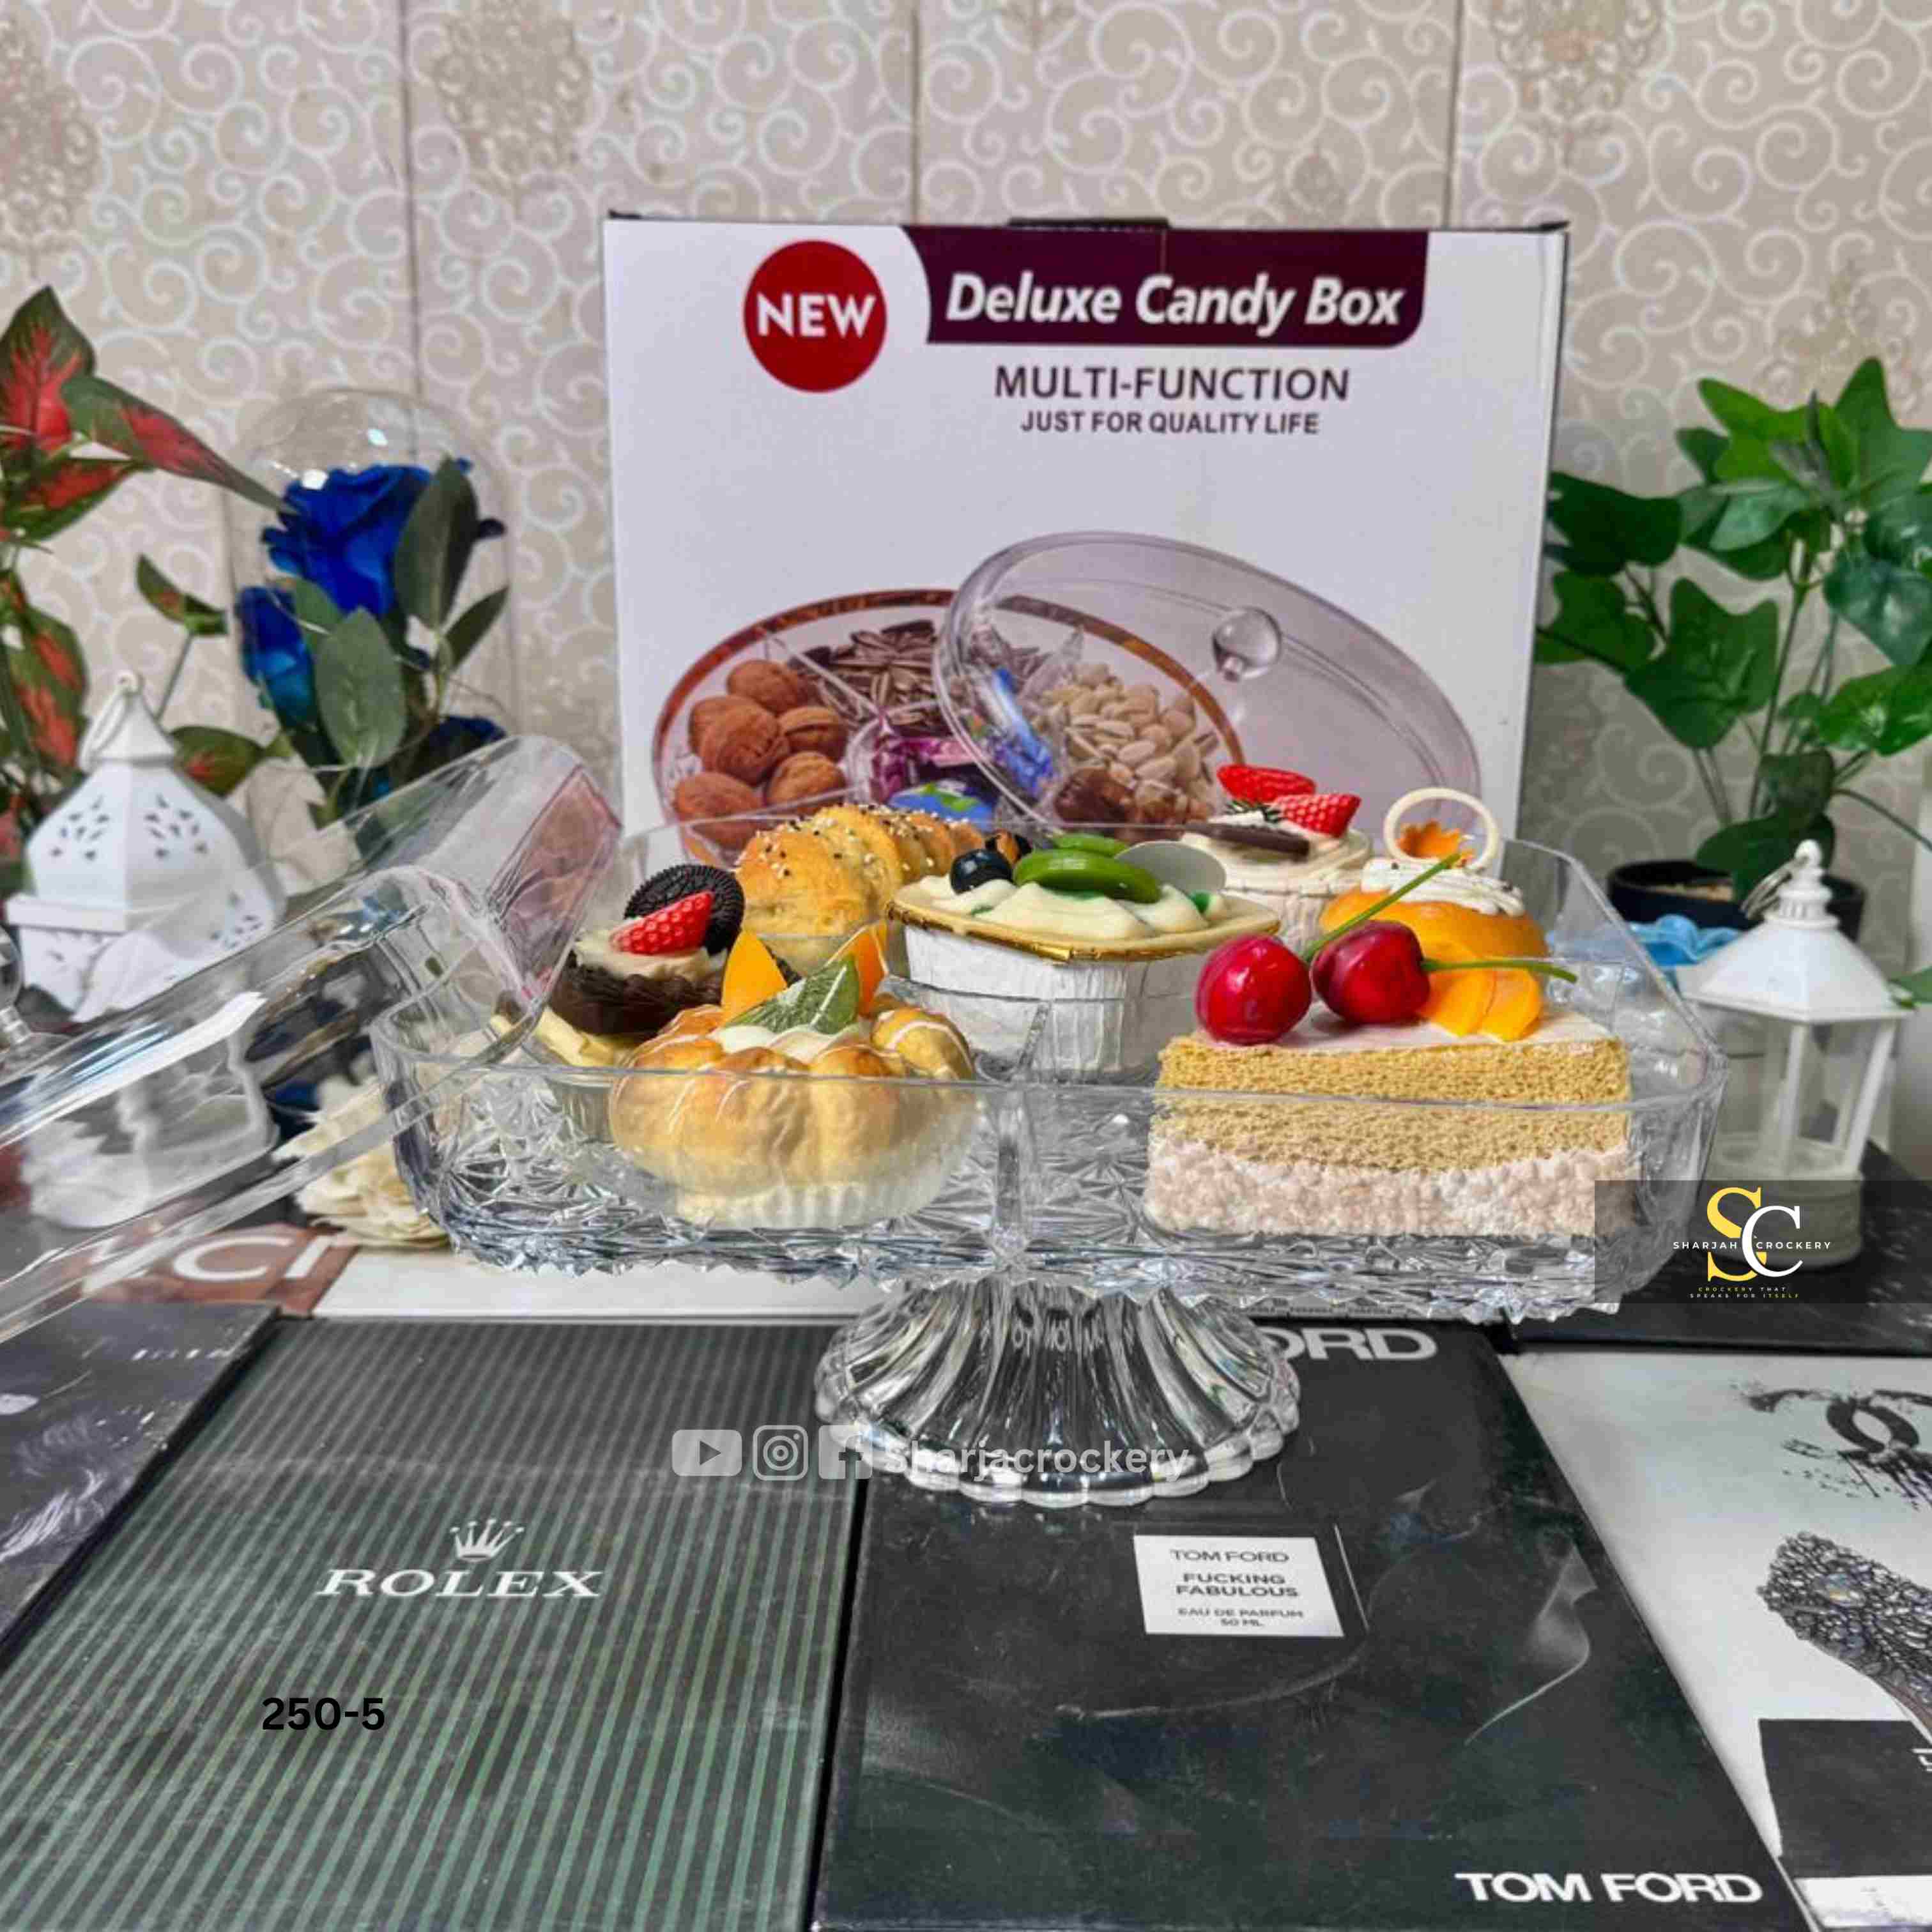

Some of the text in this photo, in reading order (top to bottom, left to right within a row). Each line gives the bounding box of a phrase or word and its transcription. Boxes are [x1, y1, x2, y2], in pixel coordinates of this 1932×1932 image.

[756, 292, 876, 337] NEW
[946, 270, 1405, 337] Deluxe Candy Box
[994, 366, 1350, 401] MULTI-FUNCTION
[1021, 412, 1319, 435] JUST FOR QUALITY LIFE
[1170, 1550, 1289, 1562] TOM FORD
[316, 1569, 602, 1597] ROLEX
[1176, 1586, 1298, 1597] FABULOUS
[1183, 1574, 1285, 1584] FUCKING
[1239, 1609, 1304, 1618] PARFUM
[1454, 1873, 1763, 1903] TOM FORD
